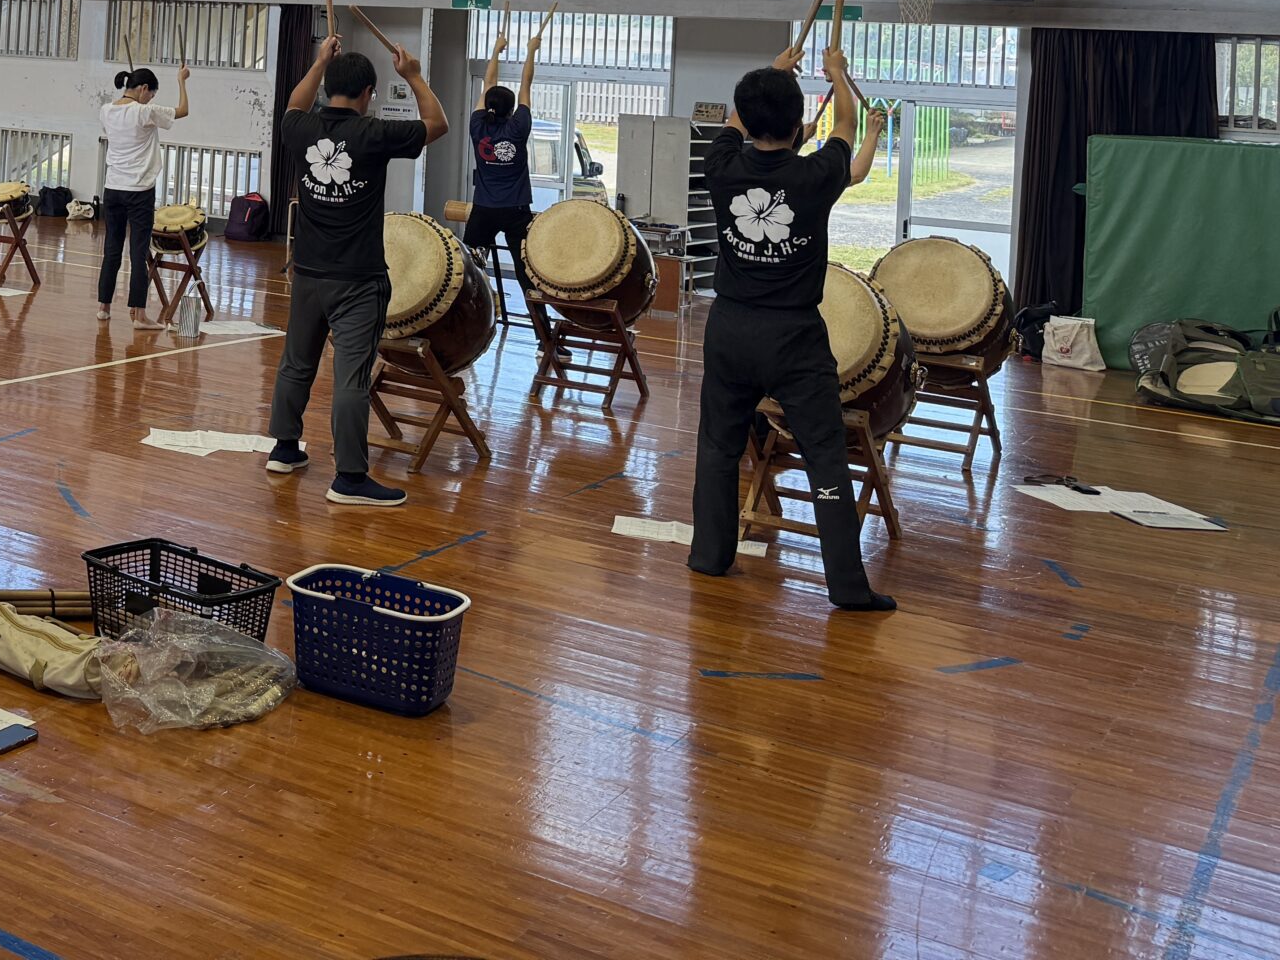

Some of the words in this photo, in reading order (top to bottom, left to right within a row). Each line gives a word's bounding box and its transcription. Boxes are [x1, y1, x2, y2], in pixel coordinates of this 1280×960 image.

[301, 174, 327, 195] Yoron
[722, 226, 755, 253] Yoron
[764, 235, 812, 256] J.H.S.
